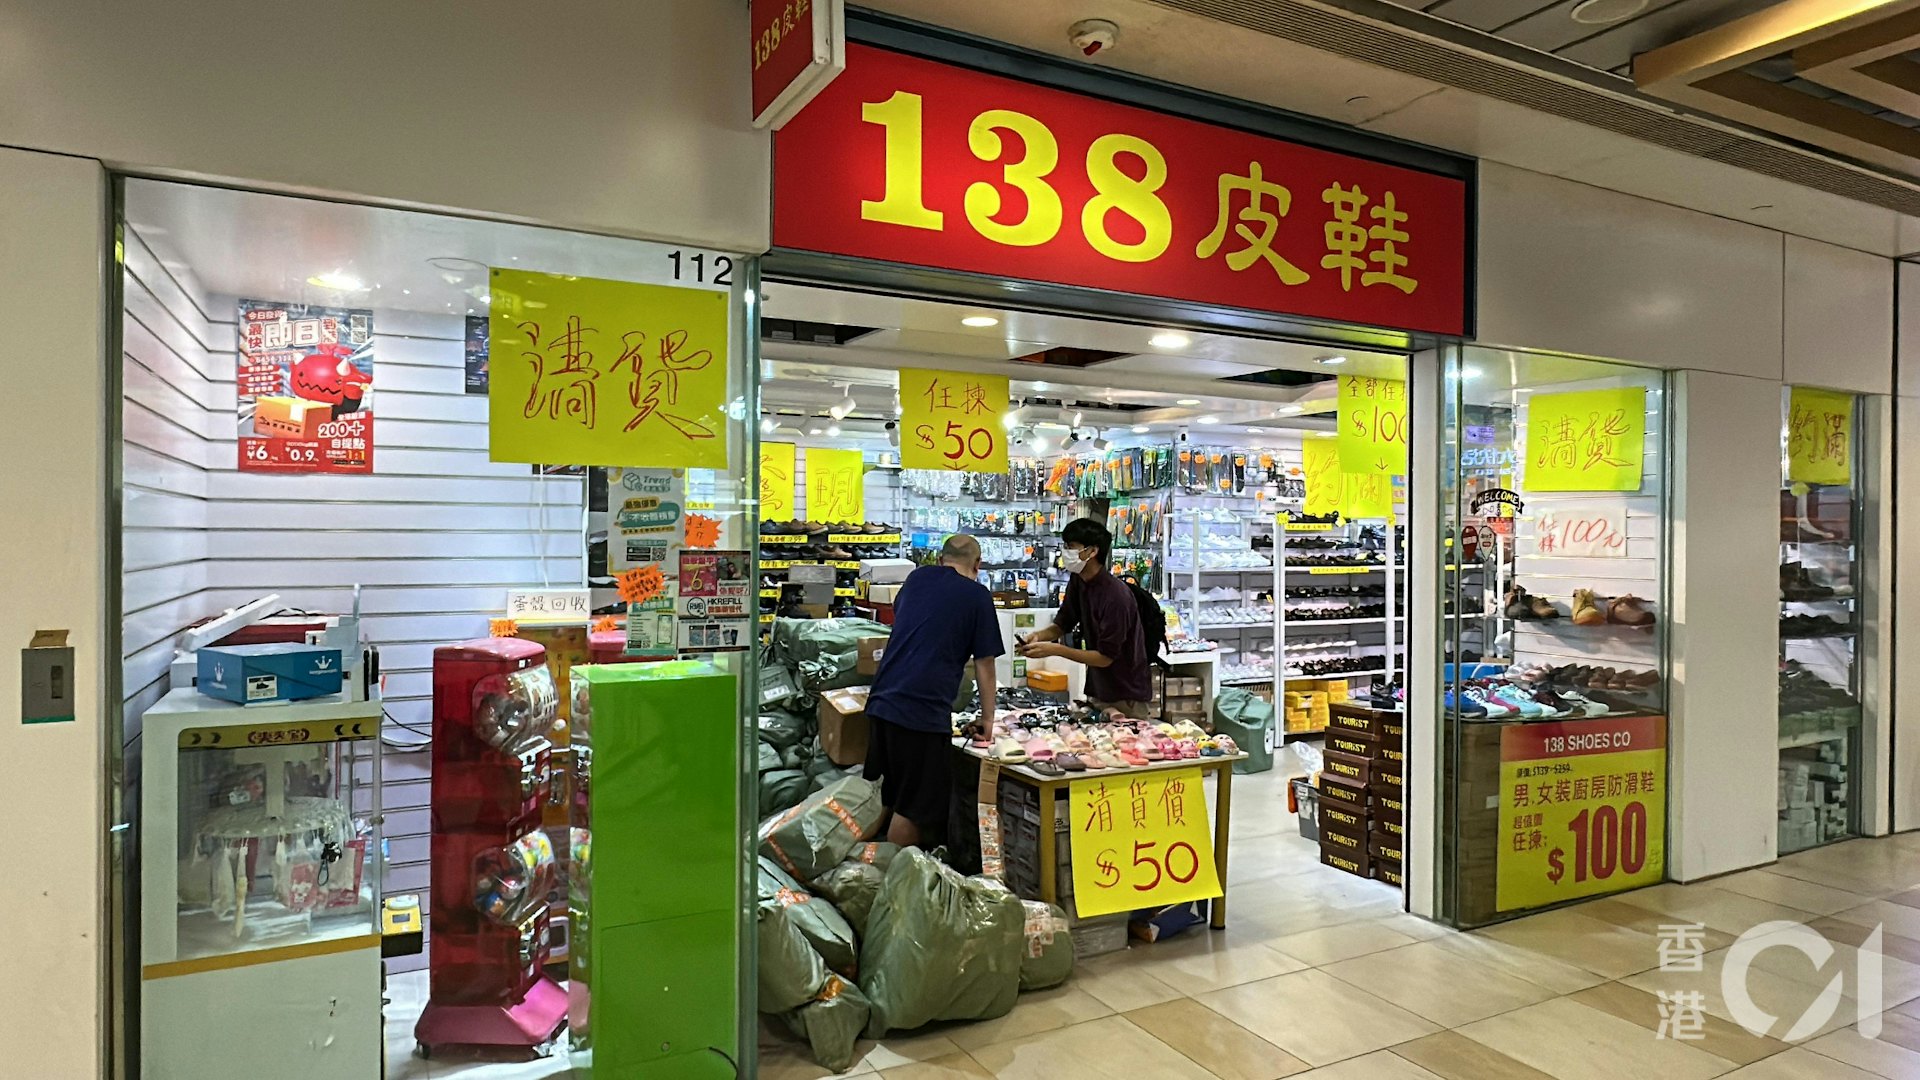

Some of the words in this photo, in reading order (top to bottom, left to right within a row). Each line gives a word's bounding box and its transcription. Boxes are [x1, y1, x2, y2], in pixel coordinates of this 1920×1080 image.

[668, 250, 733, 286] 112
[265, 319, 320, 348] 即日
[923, 378, 996, 415] 任揀
[318, 420, 365, 438] 200+
[916, 420, 993, 460] $50
[1477, 489, 1519, 506] WELCOME
[707, 597, 743, 605] HKREFILL
[1544, 736, 1564, 753] 138
[1567, 733, 1610, 751] SHOES
[1613, 731, 1631, 747] CO
[1085, 776, 1186, 832] 清貨價
[1546, 801, 1647, 885] $100
[1094, 840, 1199, 891] $50
